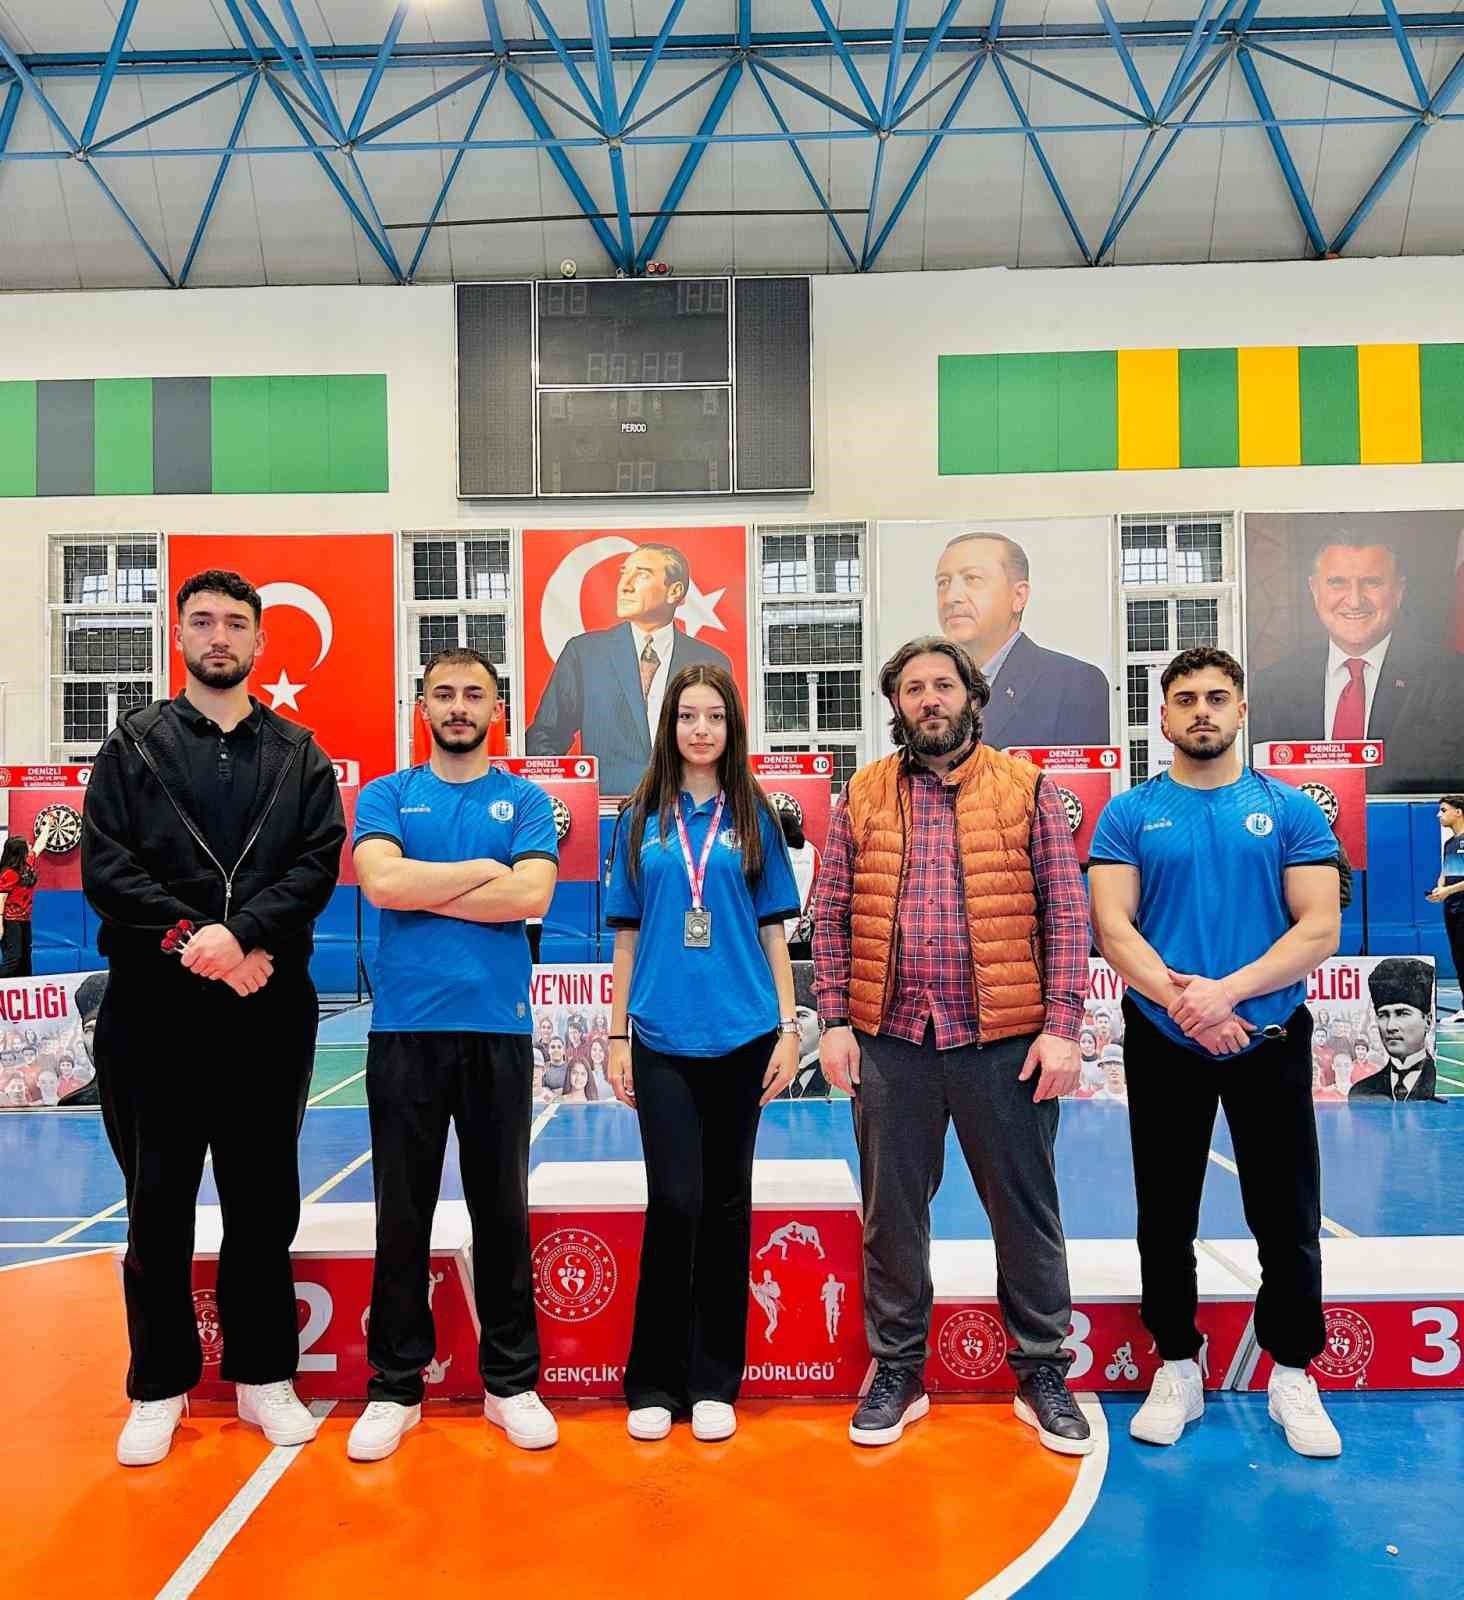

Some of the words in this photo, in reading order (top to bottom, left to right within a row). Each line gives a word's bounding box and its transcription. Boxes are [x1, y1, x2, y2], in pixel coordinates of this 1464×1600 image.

[621, 423, 647, 433] PERIOD
[1310, 744, 1345, 752] DENİZLİ
[1049, 749, 1083, 758] DENİZLİ
[1364, 749, 1376, 758] 12
[1104, 754, 1114, 763] 11
[526, 760, 559, 768] DENİZLİ
[816, 760, 827, 769] 10
[27, 767, 61, 775] DENİZLİ
[580, 765, 586, 773] 9
[82, 772, 88, 781] 7
[600, 974, 613, 1004] G
[294, 1282, 337, 1371] 2
[1411, 1306, 1461, 1376] 3
[544, 1363, 619, 1387] GENÇLİK
